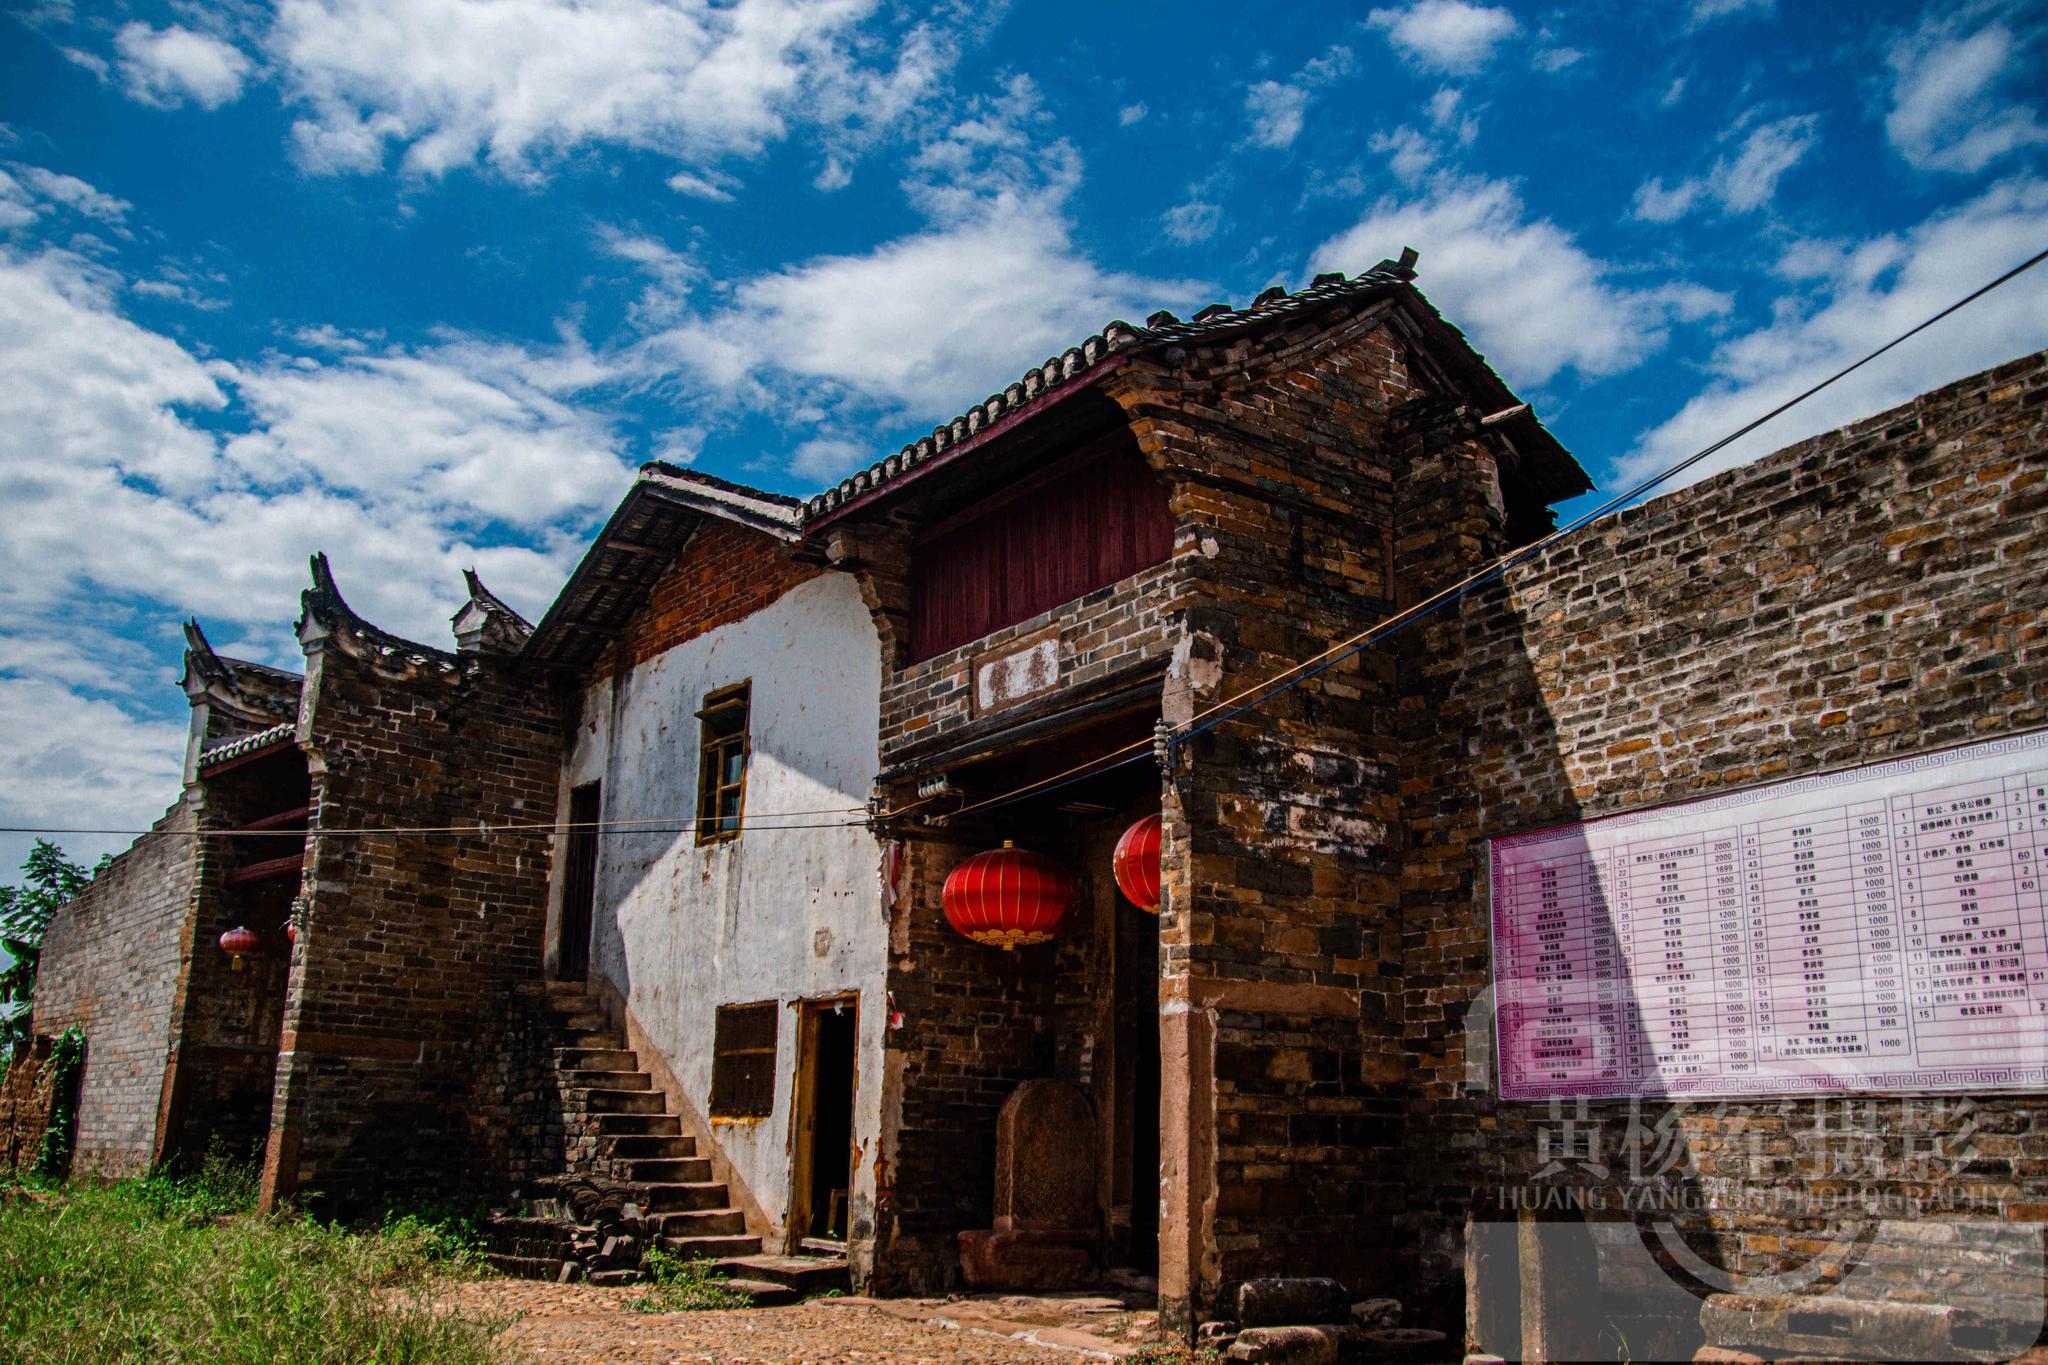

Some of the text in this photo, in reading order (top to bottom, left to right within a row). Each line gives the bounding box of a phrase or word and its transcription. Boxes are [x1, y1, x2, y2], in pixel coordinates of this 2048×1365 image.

[2014, 792, 2021, 802] 2
[2015, 806, 2022, 816] 3
[1746, 815, 1879, 845] 41 1000
[1949, 829, 1974, 841] 大香炉
[2017, 821, 2024, 831] 2
[1746, 827, 1881, 857] 42 李八斤 1000
[1617, 858, 1626, 867] 21
[1713, 841, 1732, 851] 2000
[1747, 840, 1882, 868] 43 1000
[2017, 850, 2031, 861] 60
[1618, 852, 1733, 878] 22 2000
[1748, 871, 1759, 880] 44
[1862, 852, 1883, 863] 1000
[2022, 865, 2029, 875] 2
[1588, 872, 1608, 883] 20000
[1619, 863, 1733, 888] 23 1699
[1749, 883, 1760, 891] 45
[1863, 864, 1884, 876] 1000
[1588, 883, 1608, 893] 12000
[1619, 875, 1734, 899] 24 1500
[1750, 877, 1885, 903] 46 1000
[2020, 880, 2035, 890] 60
[1589, 894, 1609, 904] 10000
[1620, 901, 1629, 910] 25
[1717, 886, 1735, 896] 1500
[1717, 898, 1736, 907] 1500
[1751, 889, 1887, 914] 47 1000
[1590, 904, 1609, 914] 10000
[1752, 902, 1888, 926] 48 1000
[1590, 915, 1610, 925] 10000
[1621, 909, 1737, 932] 27 1200
[1719, 921, 1738, 930] 1000
[1591, 926, 1611, 936] 10000
[1753, 929, 1763, 938] 49
[1868, 915, 1889, 925] 1000
[1593, 936, 1610, 947] 5000
[1720, 932, 1739, 942] 1000
[1754, 941, 1765, 950] 50
[1869, 927, 1890, 938] 1000
[1911, 937, 1922, 947] 10
[1593, 947, 1610, 958] 5000
[1721, 944, 1740, 954] 1000
[1755, 953, 1764, 962] 51
[1870, 940, 1891, 950] 1000
[1722, 955, 1741, 965] 1000
[1913, 951, 1923, 961] 11
[1594, 958, 1611, 968] 5000
[1756, 952, 1893, 975] 52 1000
[1595, 969, 1612, 979] 5000
[1723, 967, 1742, 977] 1000
[1872, 965, 1894, 976] 1000
[1914, 966, 1925, 975] 12
[1724, 979, 1743, 989] 1000
[1915, 980, 1927, 990] 13
[2032, 971, 2044, 981] 91
[1758, 990, 1769, 998] 54
[1874, 978, 1896, 989] 1000
[1626, 991, 1744, 1009] 34 1000
[1759, 991, 1897, 1011] 55 1000
[1917, 995, 1928, 1004] 14
[1726, 1003, 1745, 1013] 1000
[1760, 1014, 1771, 1022] 56
[1876, 1005, 1898, 1014] 1000
[1918, 1009, 1930, 1019] 15
[2039, 1001, 2046, 1012] 2
[1726, 1015, 1745, 1024] 1000
[1761, 1018, 1897, 1034] 57 888
[1628, 1027, 1746, 1043] 37 1000
[1628, 1045, 1638, 1054] 38
[1728, 1039, 1747, 1048] 1000
[1880, 1039, 1901, 1048] 1000
[1729, 1051, 1748, 1060] 1000
[1601, 1057, 1617, 1067] 2000
[1601, 1069, 1618, 1078] 2000
[1630, 1063, 1749, 1076] 40 1000
